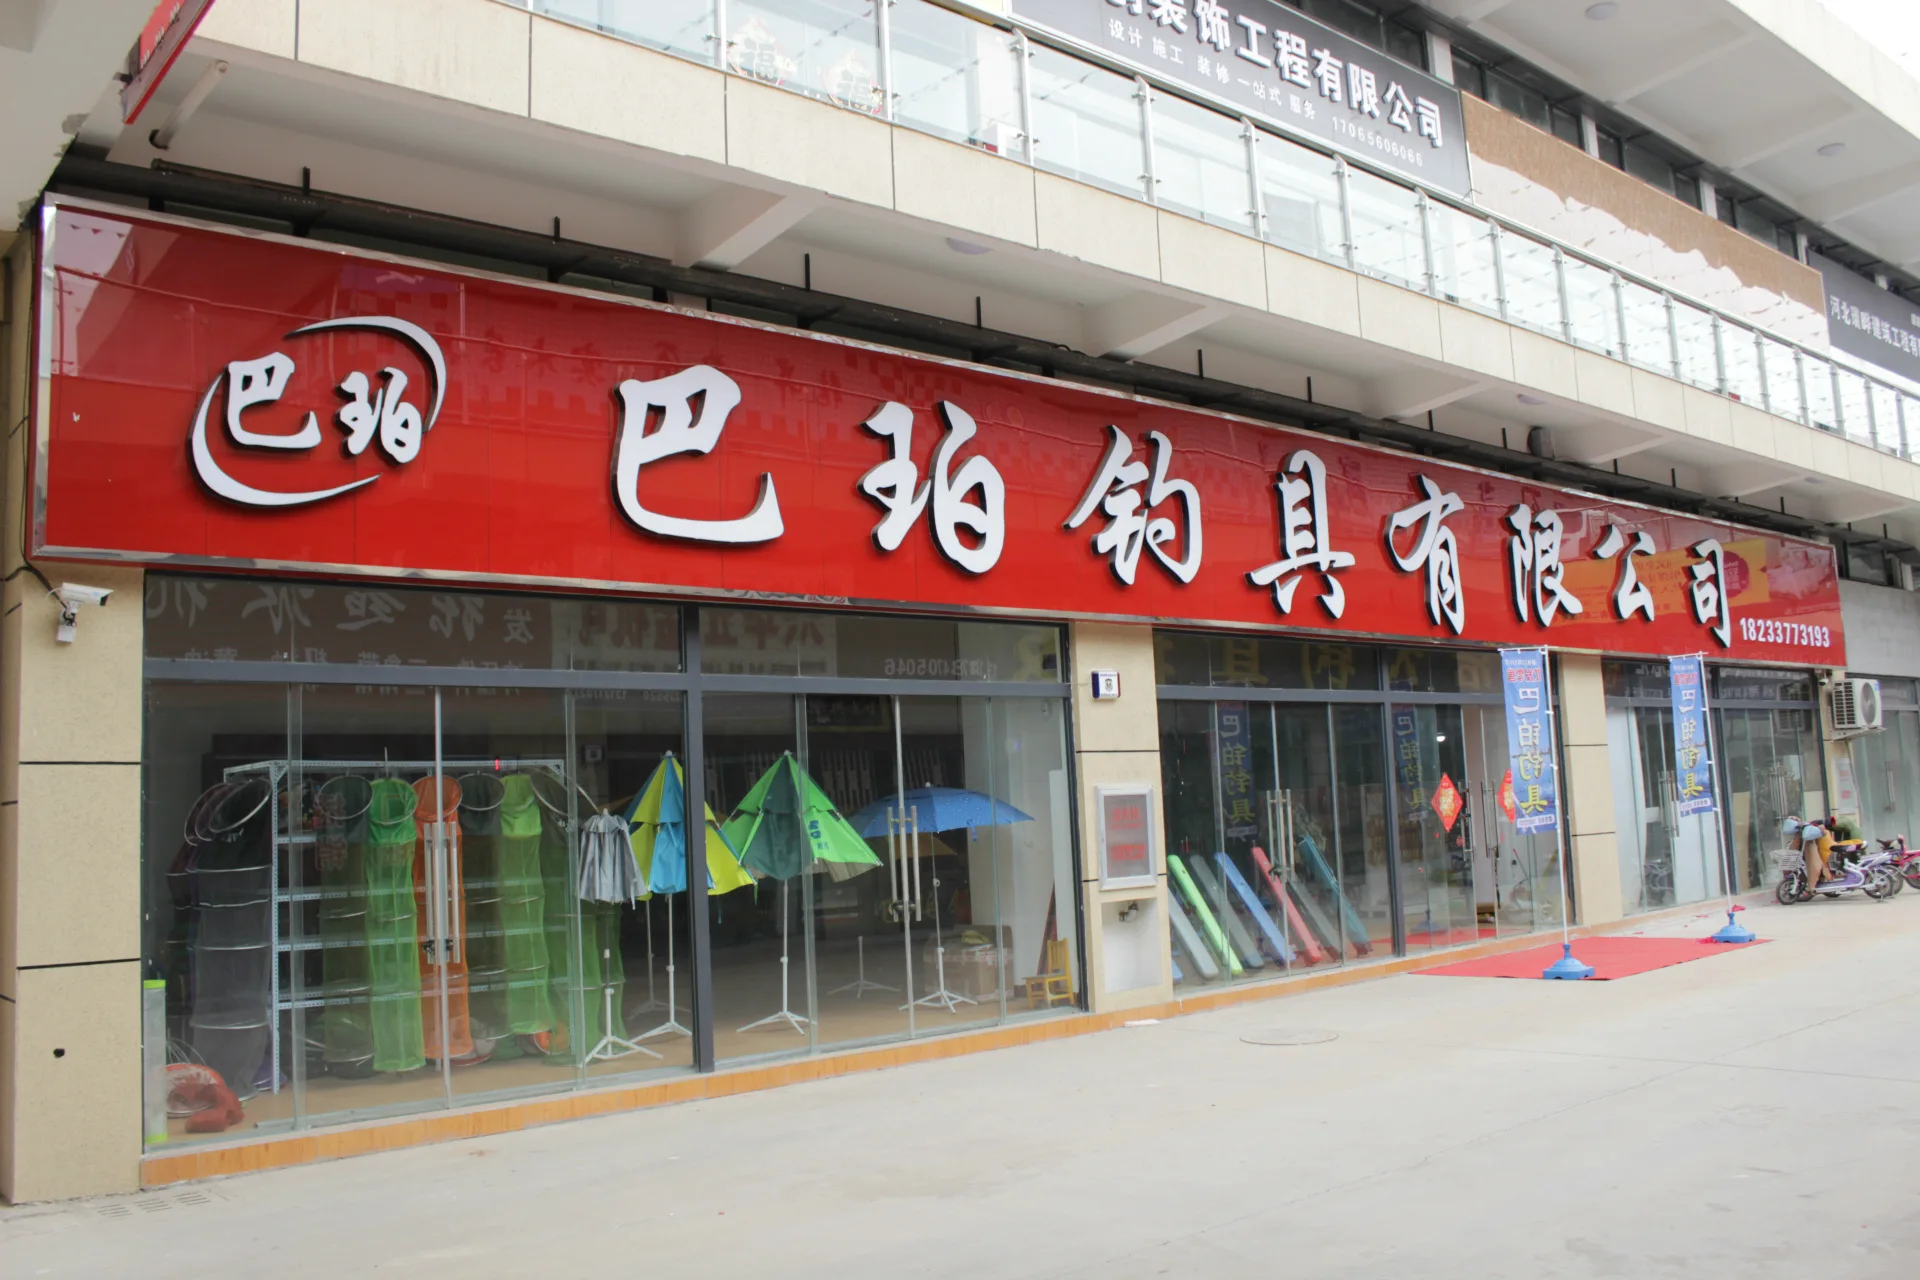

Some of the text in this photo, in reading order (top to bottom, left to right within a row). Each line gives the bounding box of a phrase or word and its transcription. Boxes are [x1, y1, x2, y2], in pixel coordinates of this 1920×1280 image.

[1106, 0, 1443, 148] 装饰工程有限公司
[1108, 18, 1143, 50] 设计
[1151, 36, 1184, 65] 施工
[1197, 55, 1230, 85] 装修
[1237, 77, 1282, 107] 一站式
[1289, 94, 1316, 121] 服务
[1739, 617, 1831, 648] 18233773193
